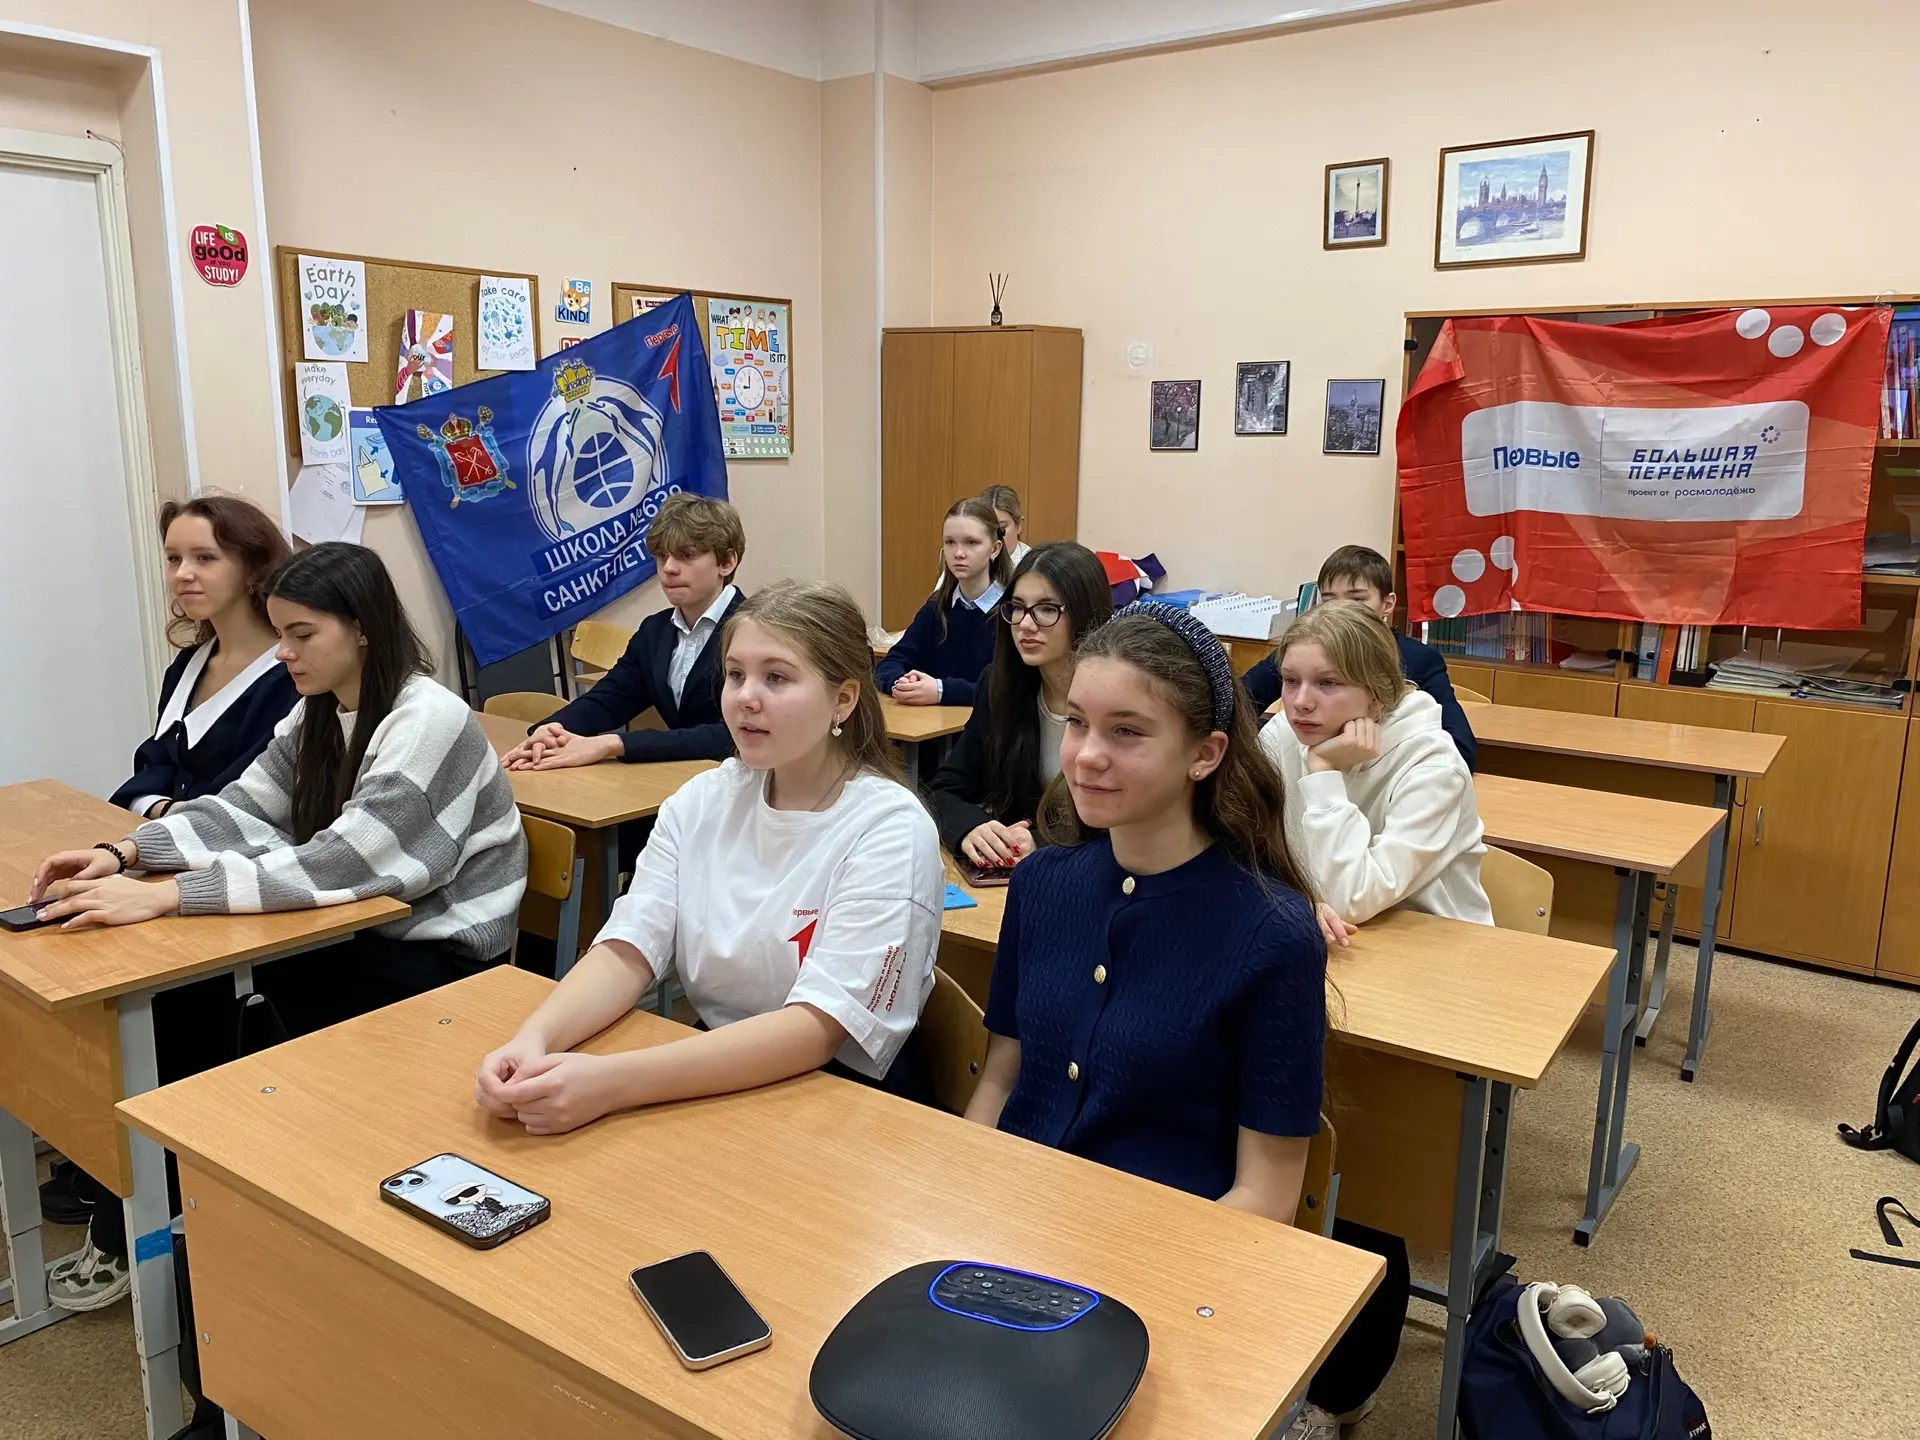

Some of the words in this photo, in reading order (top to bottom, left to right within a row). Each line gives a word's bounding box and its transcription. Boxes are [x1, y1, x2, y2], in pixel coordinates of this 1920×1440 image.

[195, 230, 216, 246] LIFE
[224, 232, 235, 242] IS
[204, 265, 239, 282] STUDY!
[306, 267, 356, 288] Earth
[313, 284, 350, 304] Day
[480, 286, 498, 298] Take
[501, 287, 526, 303] care
[575, 281, 590, 294] Be
[557, 306, 589, 324] KIND!
[711, 313, 730, 325] WHAT
[644, 323, 679, 348] Первые
[716, 325, 780, 353] TIME
[769, 353, 776, 363] IS
[777, 353, 787, 364] IT?
[304, 363, 327, 374] Make
[301, 374, 336, 386] everyday
[1631, 445, 1758, 463] БОЛЬШАЯ
[1627, 463, 1753, 480] ПЕРЕМЕНА
[1627, 489, 1657, 497] проект
[1659, 489, 1670, 497] от
[544, 520, 627, 573] ШКОЛА
[543, 538, 647, 612] САНКТ-ПЕТ
